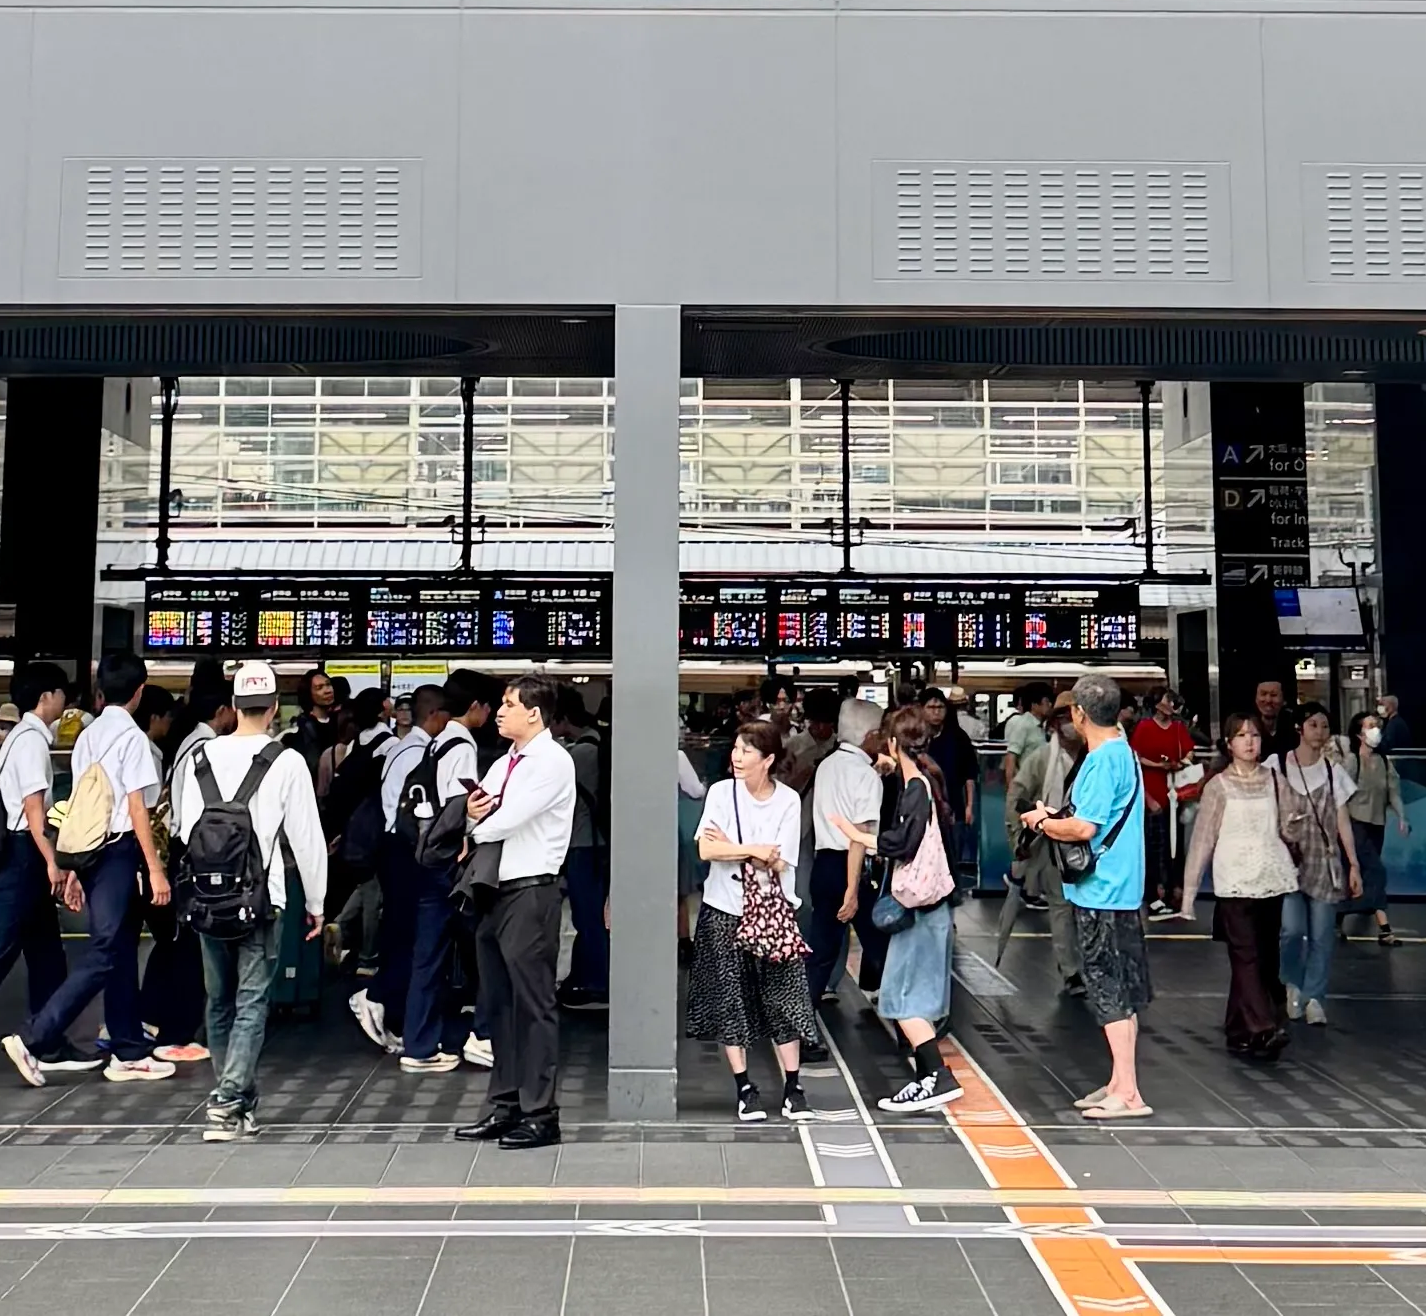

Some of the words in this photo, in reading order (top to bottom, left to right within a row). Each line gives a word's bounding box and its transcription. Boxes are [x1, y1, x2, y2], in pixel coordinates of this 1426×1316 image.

[1222, 445, 1239, 464] A
[1269, 458, 1290, 471] for
[1224, 490, 1241, 507] D
[1271, 512, 1291, 525] for
[1270, 537, 1305, 548] Track
